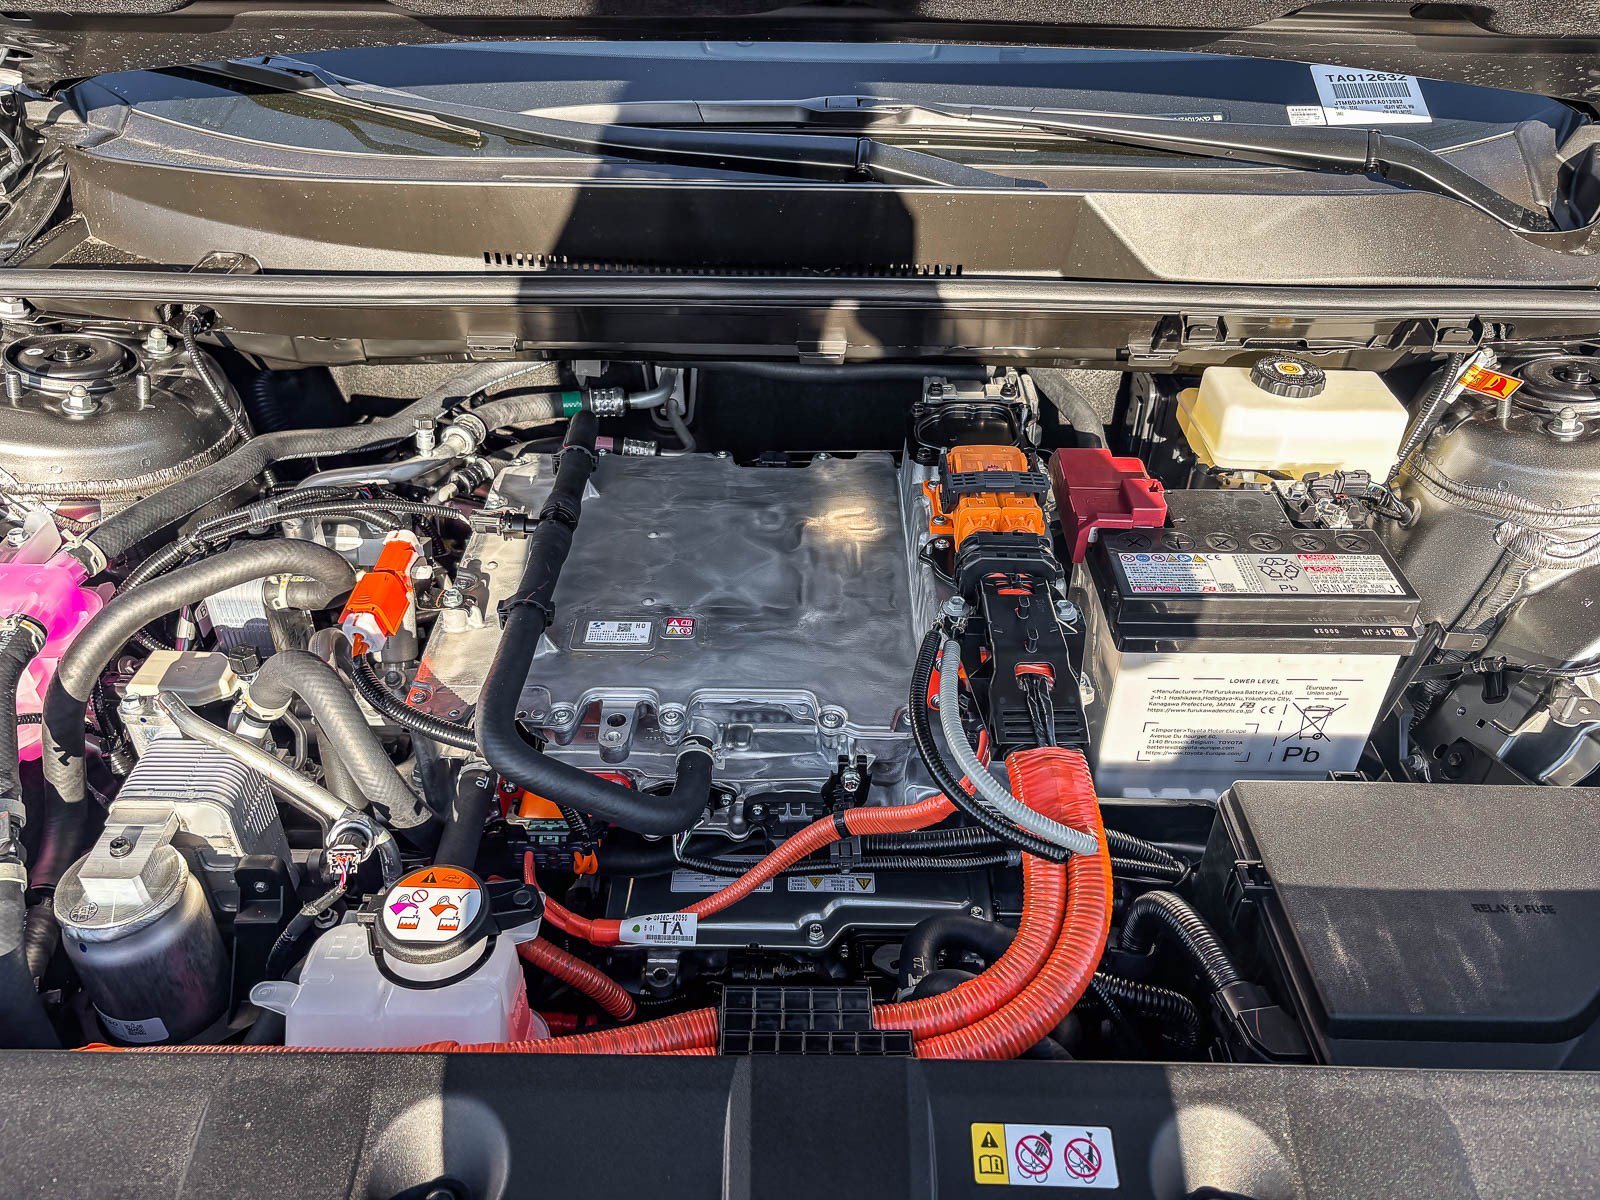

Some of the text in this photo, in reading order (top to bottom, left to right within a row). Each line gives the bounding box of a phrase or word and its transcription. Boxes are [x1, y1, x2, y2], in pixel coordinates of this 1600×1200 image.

[1325, 73, 1408, 83] TA012632
[1388, 585, 1404, 593] J1
[1282, 747, 1320, 762] Pb
[1471, 903, 1511, 913] RELAY
[1524, 904, 1557, 915] FUSE
[660, 921, 683, 935] TA
